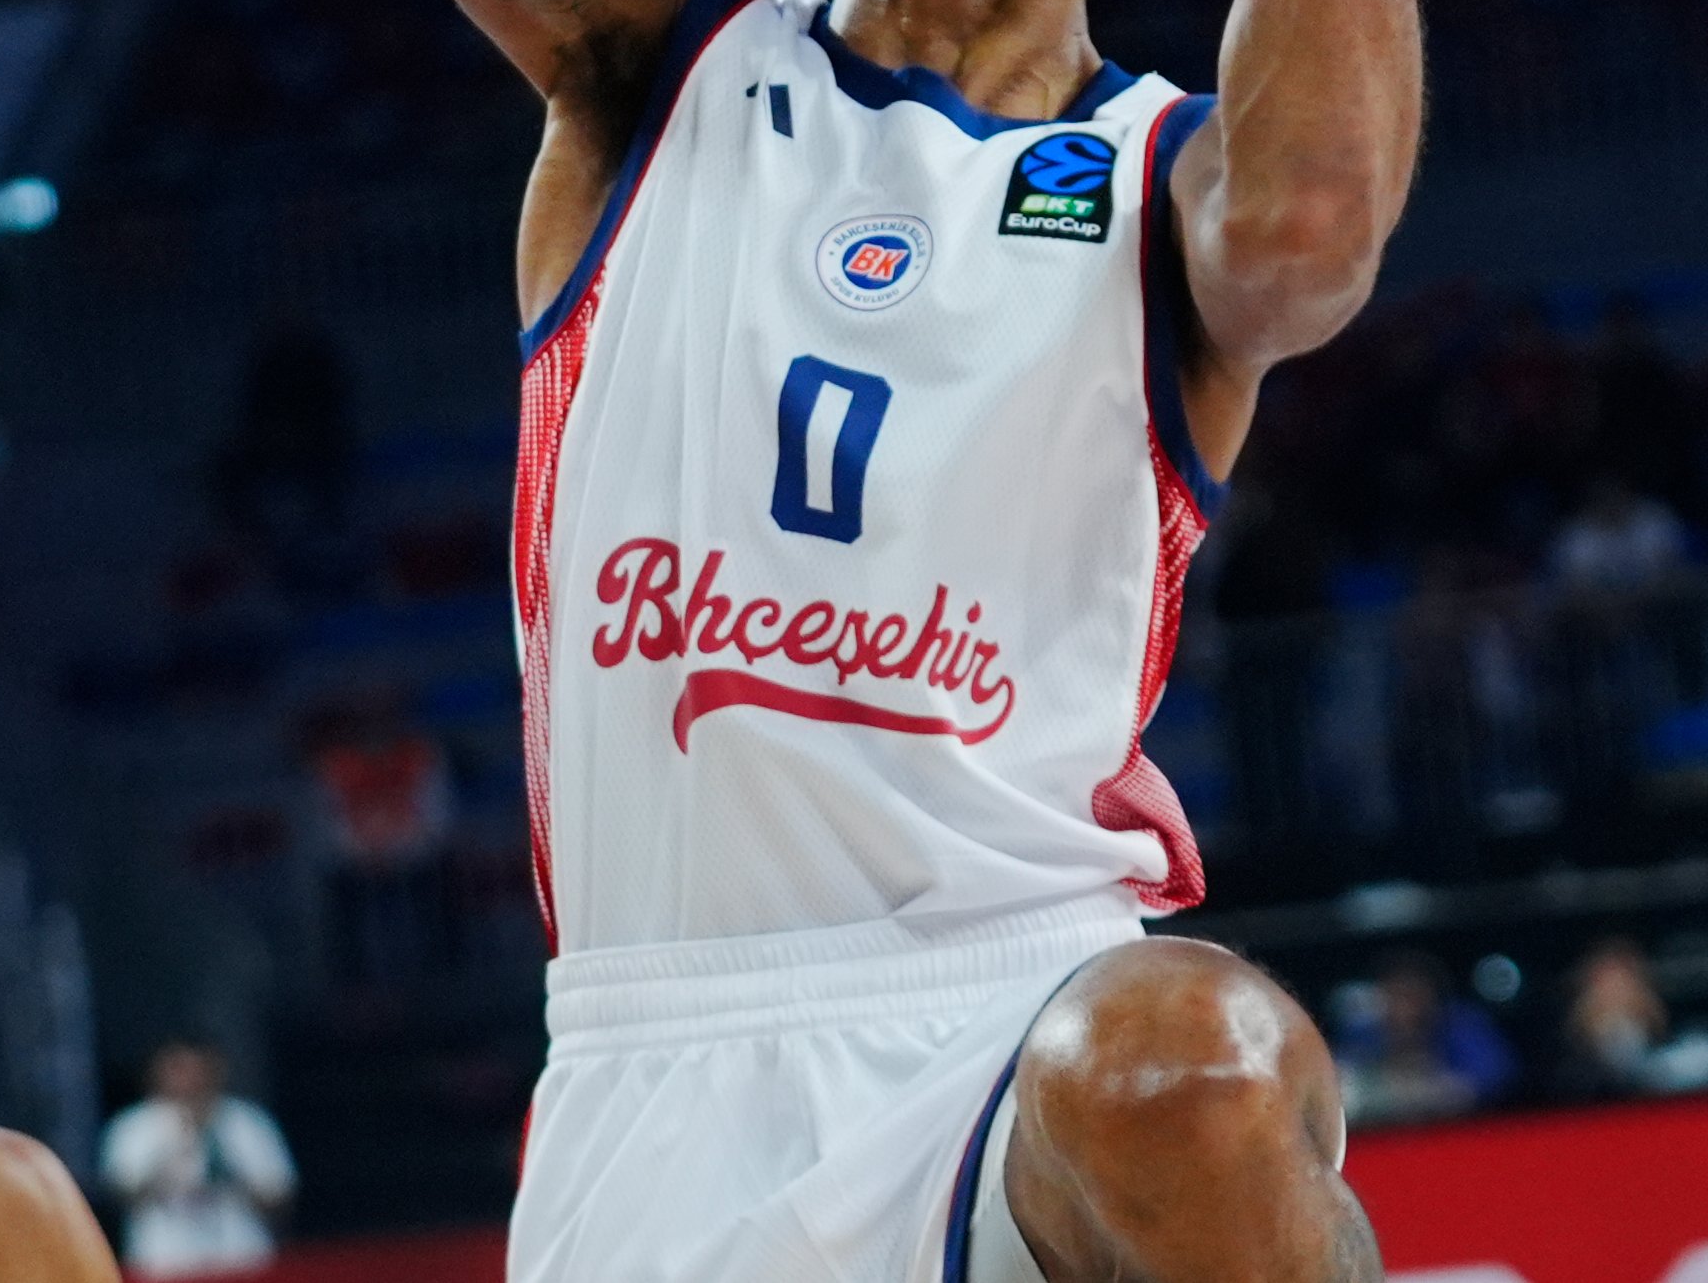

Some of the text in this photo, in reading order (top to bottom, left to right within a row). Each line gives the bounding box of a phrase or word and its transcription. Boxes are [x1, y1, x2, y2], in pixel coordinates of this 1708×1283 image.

[1020, 194, 1094, 217] KT
[1006, 213, 1102, 236] EuroCup
[844, 243, 909, 280] BK
[770, 353, 893, 545] 0
